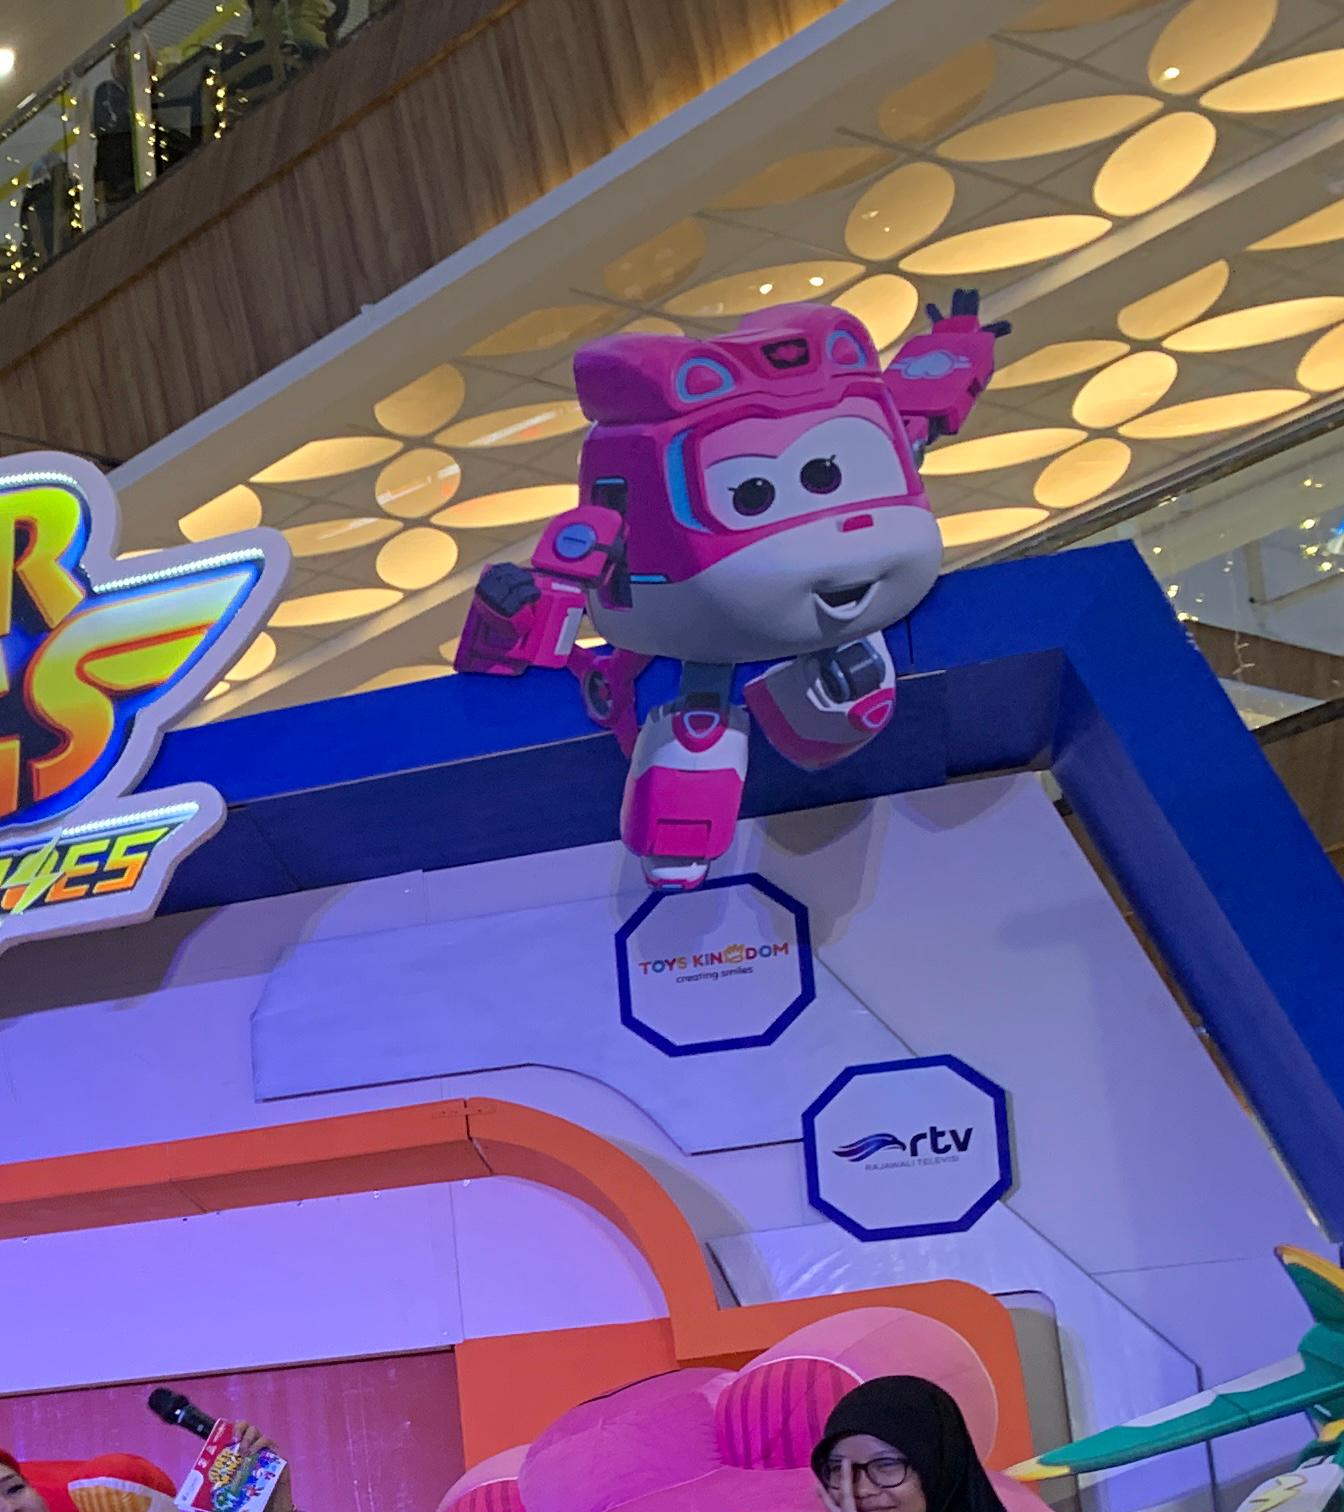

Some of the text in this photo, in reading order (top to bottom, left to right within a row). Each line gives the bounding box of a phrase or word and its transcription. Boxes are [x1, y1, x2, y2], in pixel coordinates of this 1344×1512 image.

[638, 956, 688, 975] TOYS
[676, 966, 753, 984] creating smiles
[910, 1126, 974, 1157] rtv
[865, 1156, 960, 1171] RAJAWALI TELEVISI
